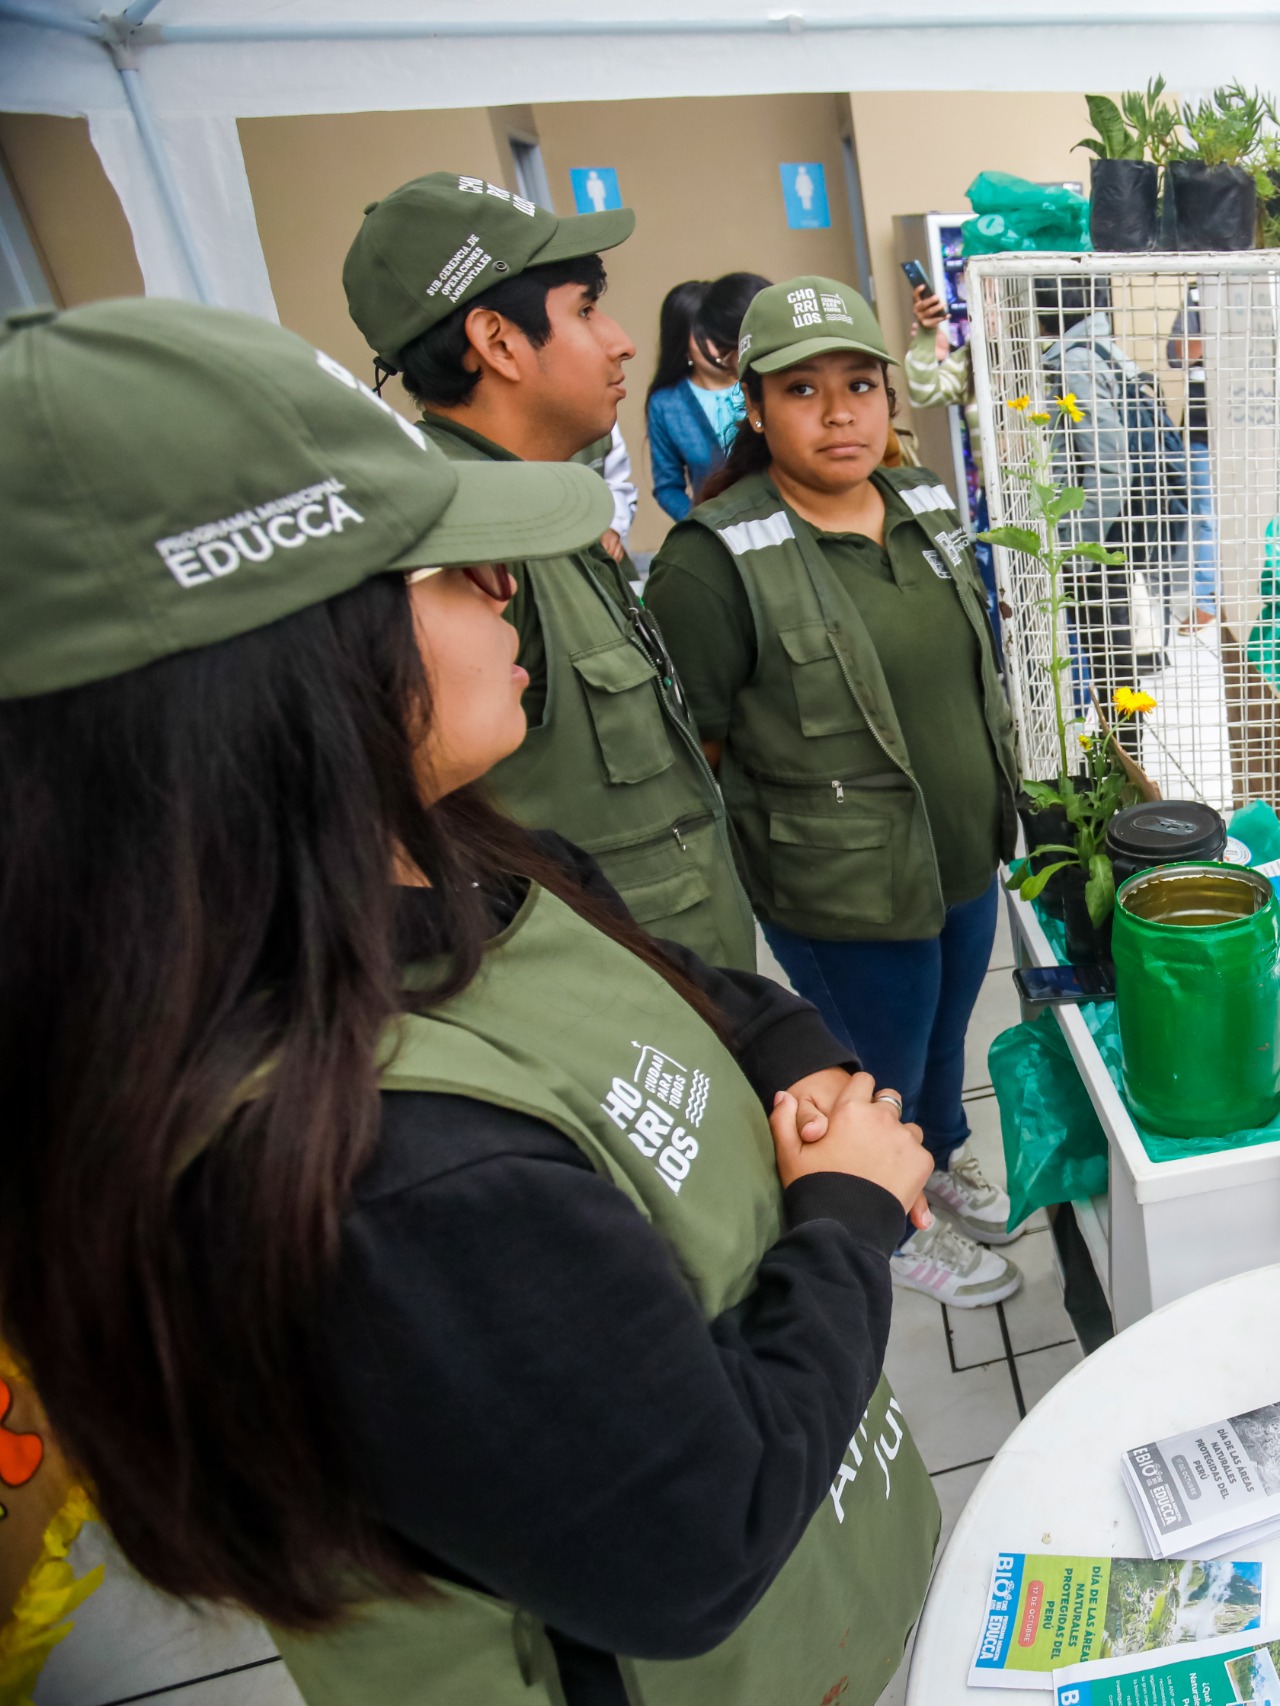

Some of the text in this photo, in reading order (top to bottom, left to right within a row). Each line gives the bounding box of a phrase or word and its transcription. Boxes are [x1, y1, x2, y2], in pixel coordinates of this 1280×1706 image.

[467, 234, 480, 247] DE
[441, 246, 484, 296] OPERACIONES
[449, 253, 492, 303] AMBIENTALES
[787, 288, 816, 304] CHO
[793, 299, 819, 315] RRI
[164, 495, 365, 588] EDUCCA
[644, 1054, 664, 1094] CIUDAD
[657, 1072, 673, 1103] PARA
[669, 1074, 686, 1109] TODOS
[1192, 1458, 1210, 1480] PERÚ
[1194, 1438, 1230, 1500] PROTEGIDAS DEL
[1210, 1440, 1236, 1484] NATURALES
[1216, 1427, 1255, 1492] DÍA DE LAS ÁREAS
[1151, 1484, 1178, 1525] EDUCCA
[1181, 1470, 1197, 1496] OCTUBRE
[991, 1555, 1015, 1599] BIO
[1023, 1586, 1038, 1642] 17 DE OCTUBRE
[1042, 1600, 1055, 1630] PERÚ
[1050, 1567, 1073, 1660] PROTEGIDAS DEL
[1067, 1582, 1085, 1647] NATURALES
[1079, 1565, 1102, 1664] DÍA DE LAS ÁREAS
[979, 1614, 1002, 1660] EDUCCA
[1201, 1681, 1212, 1702] ¿Qué
